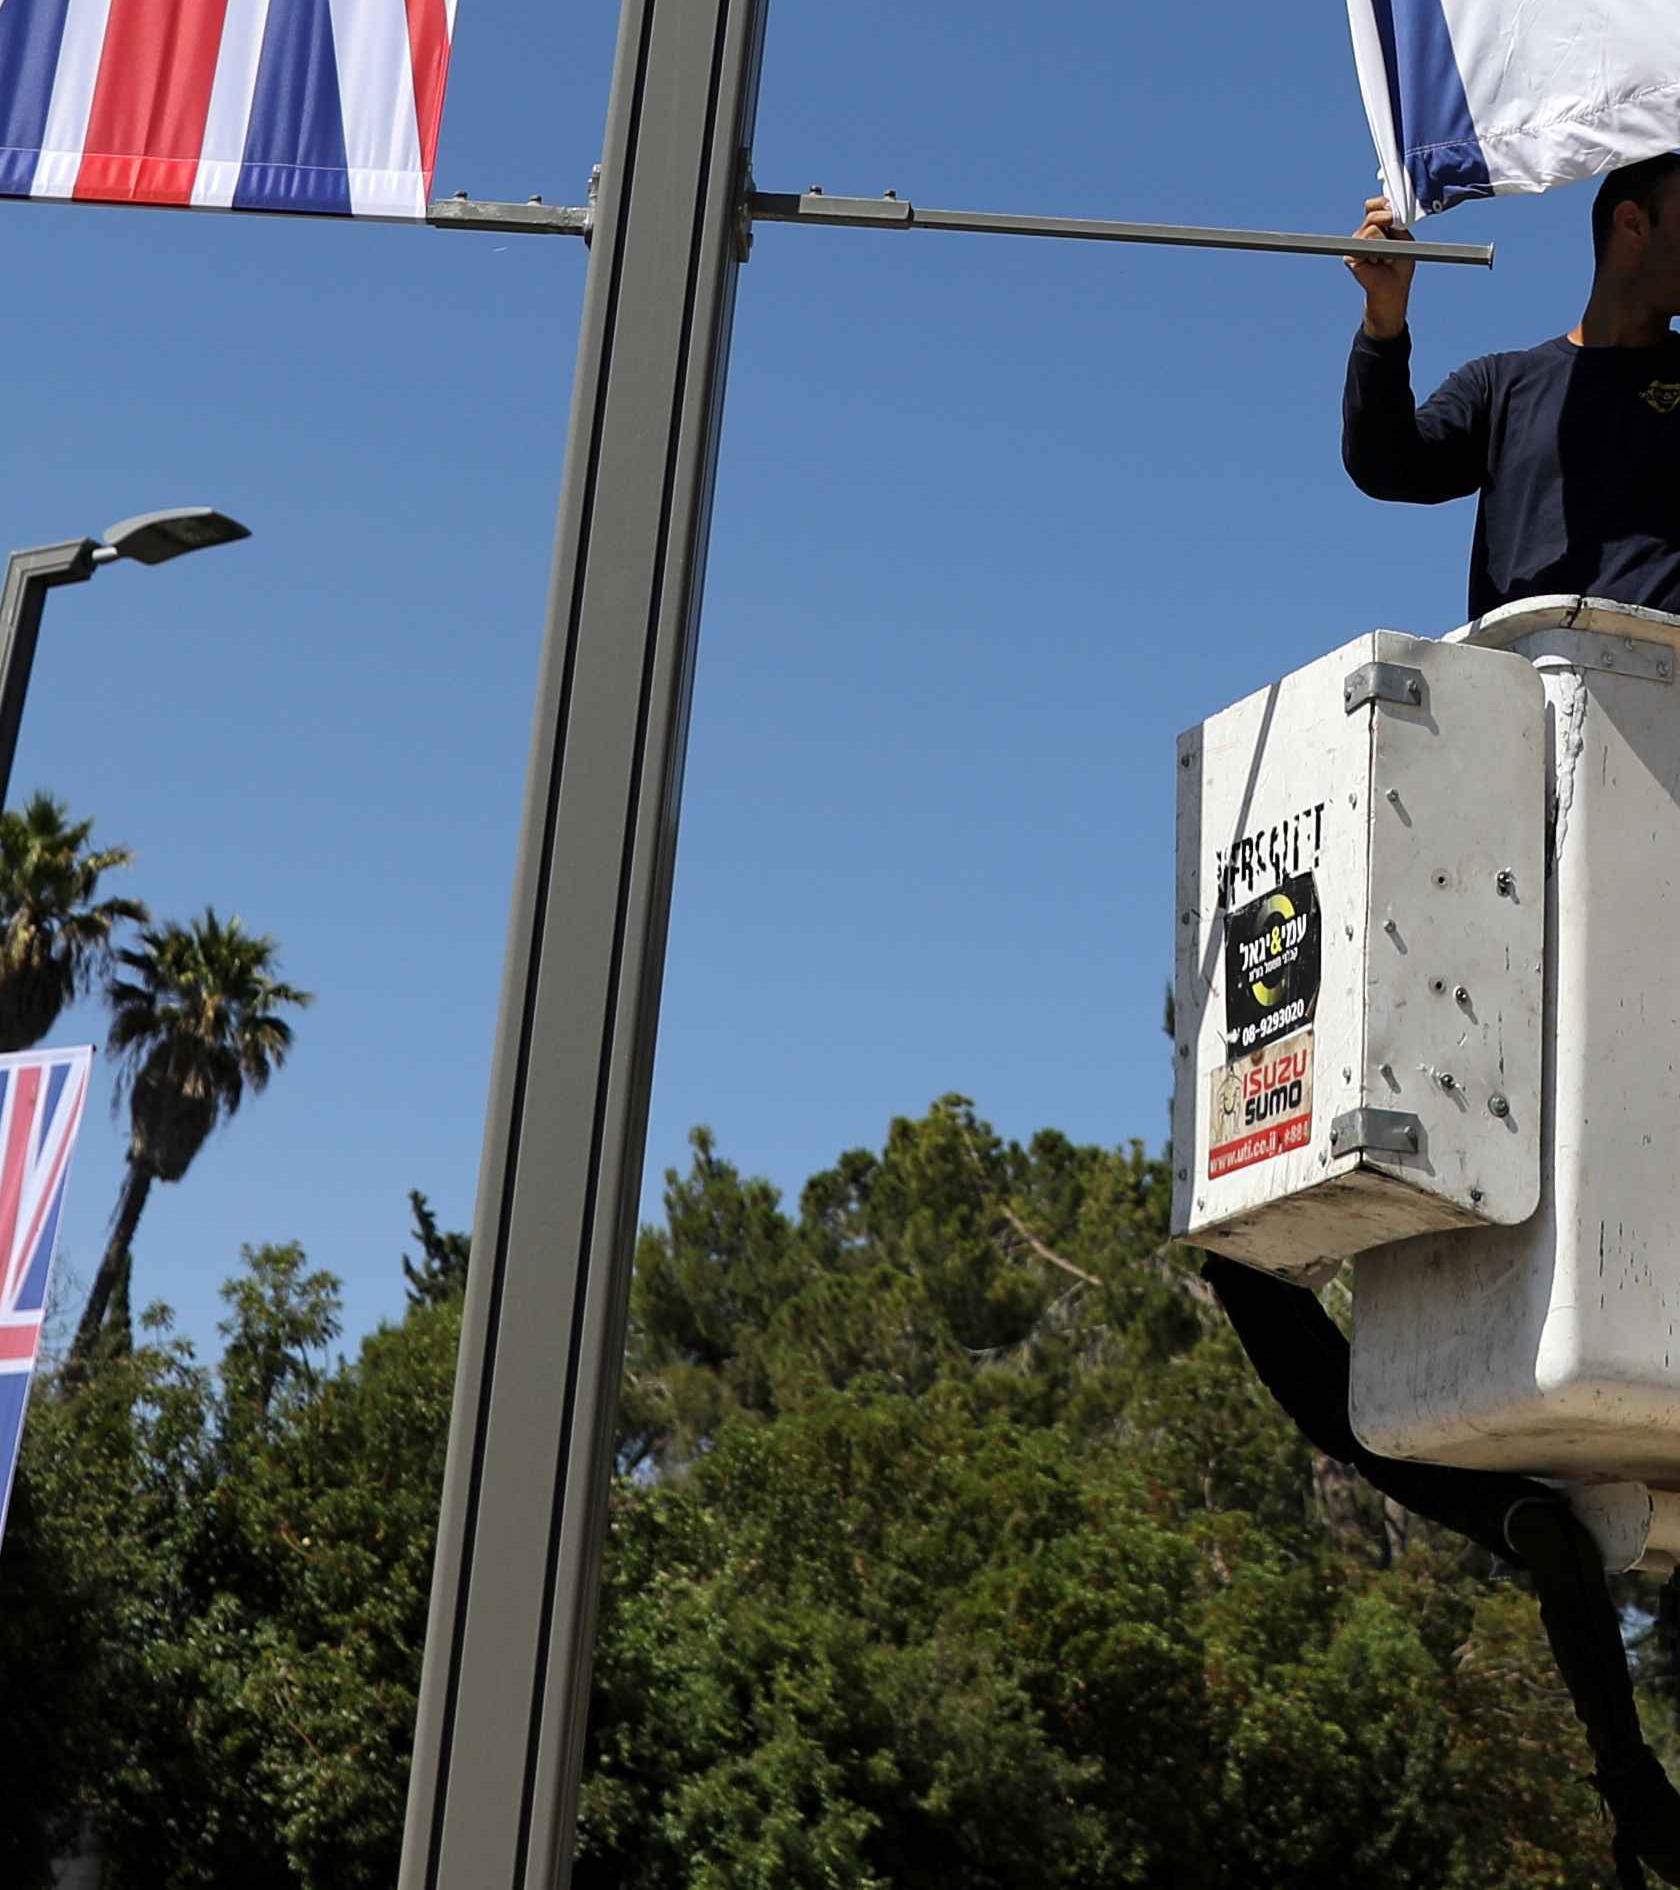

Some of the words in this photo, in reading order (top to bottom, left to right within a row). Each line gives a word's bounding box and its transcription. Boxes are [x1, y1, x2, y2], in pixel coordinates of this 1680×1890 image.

[1240, 914, 1308, 971] עמי&יגאל
[1242, 998, 1305, 1046] 08-9293020
[1243, 1048, 1308, 1099] ISUZU
[1245, 1079, 1302, 1126] SUMO
